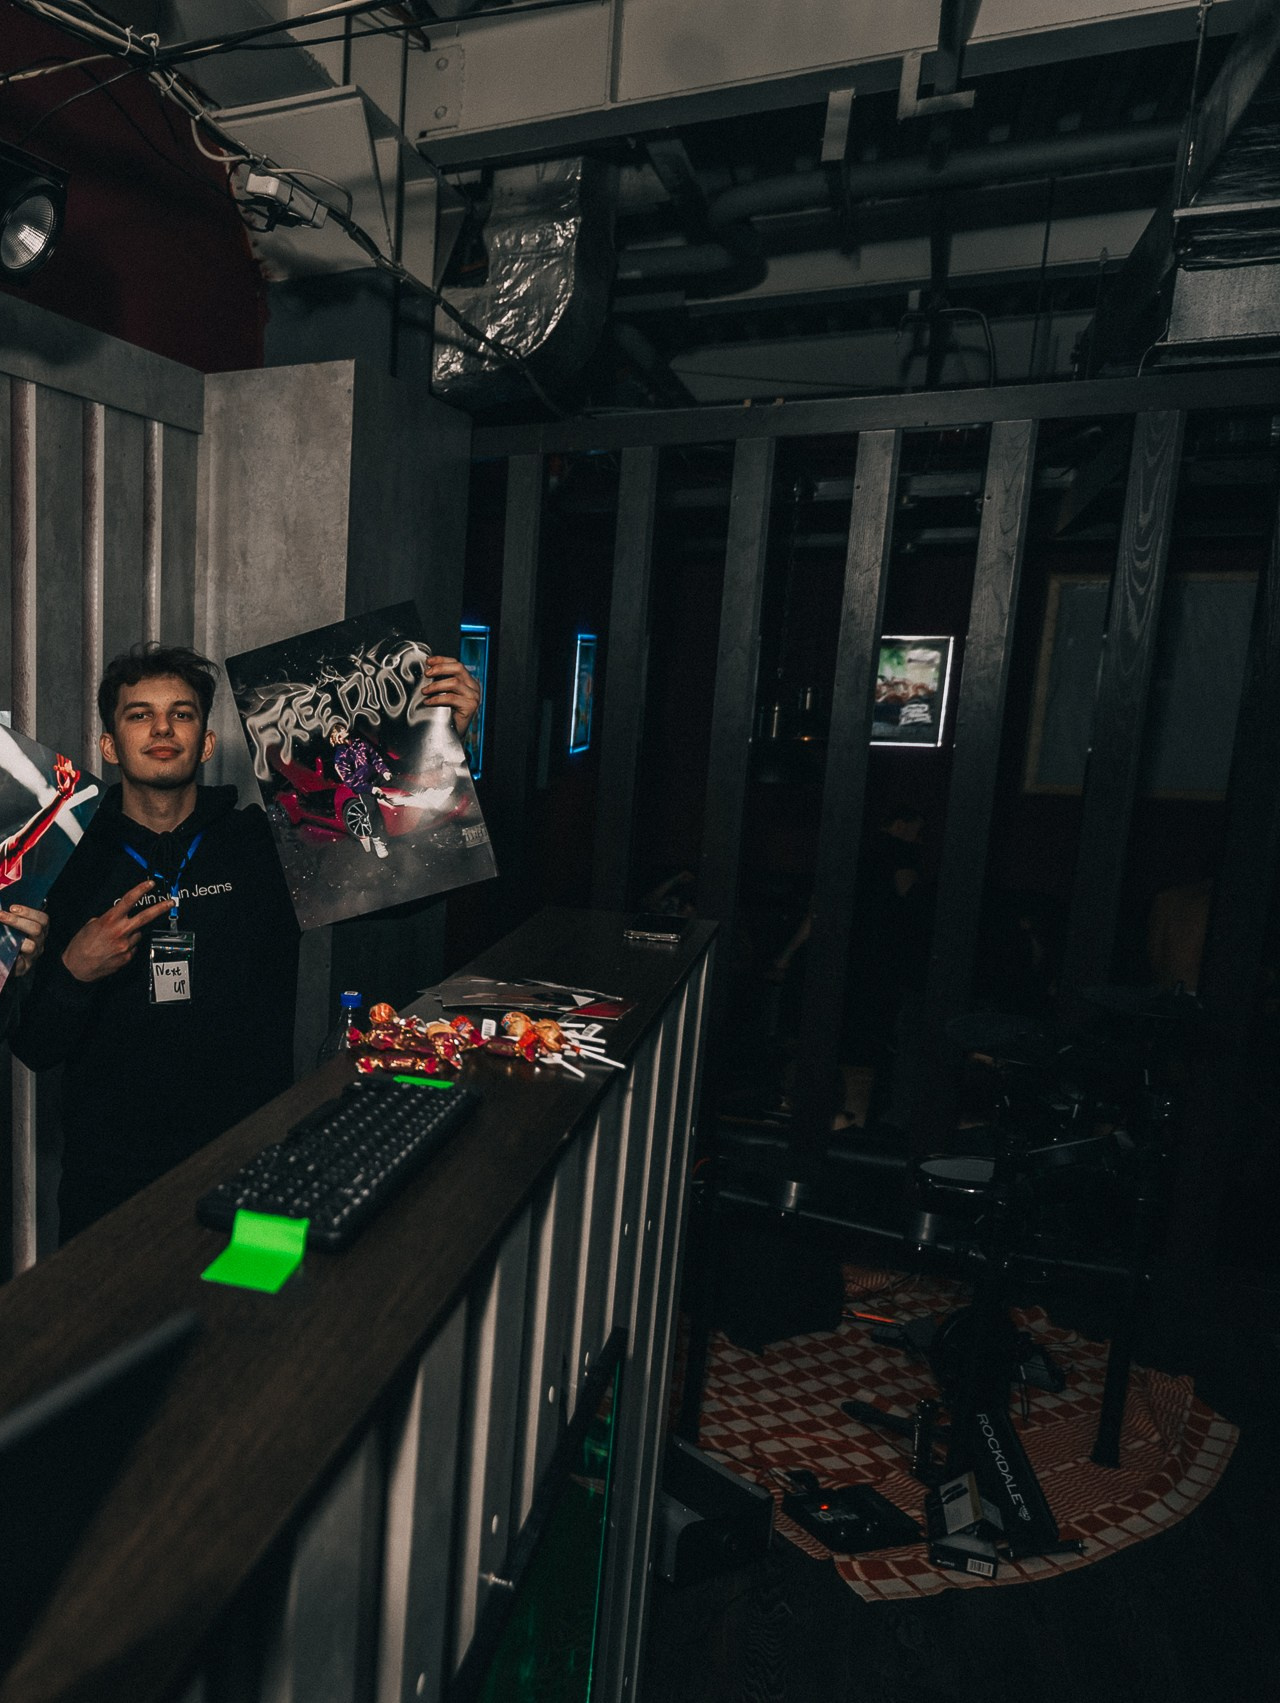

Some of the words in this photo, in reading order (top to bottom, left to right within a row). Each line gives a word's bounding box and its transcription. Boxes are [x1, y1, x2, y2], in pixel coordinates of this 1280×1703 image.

[191, 881, 233, 897] Jeans
[155, 963, 182, 977] Next
[976, 1412, 1025, 1506] ROCKDALE
